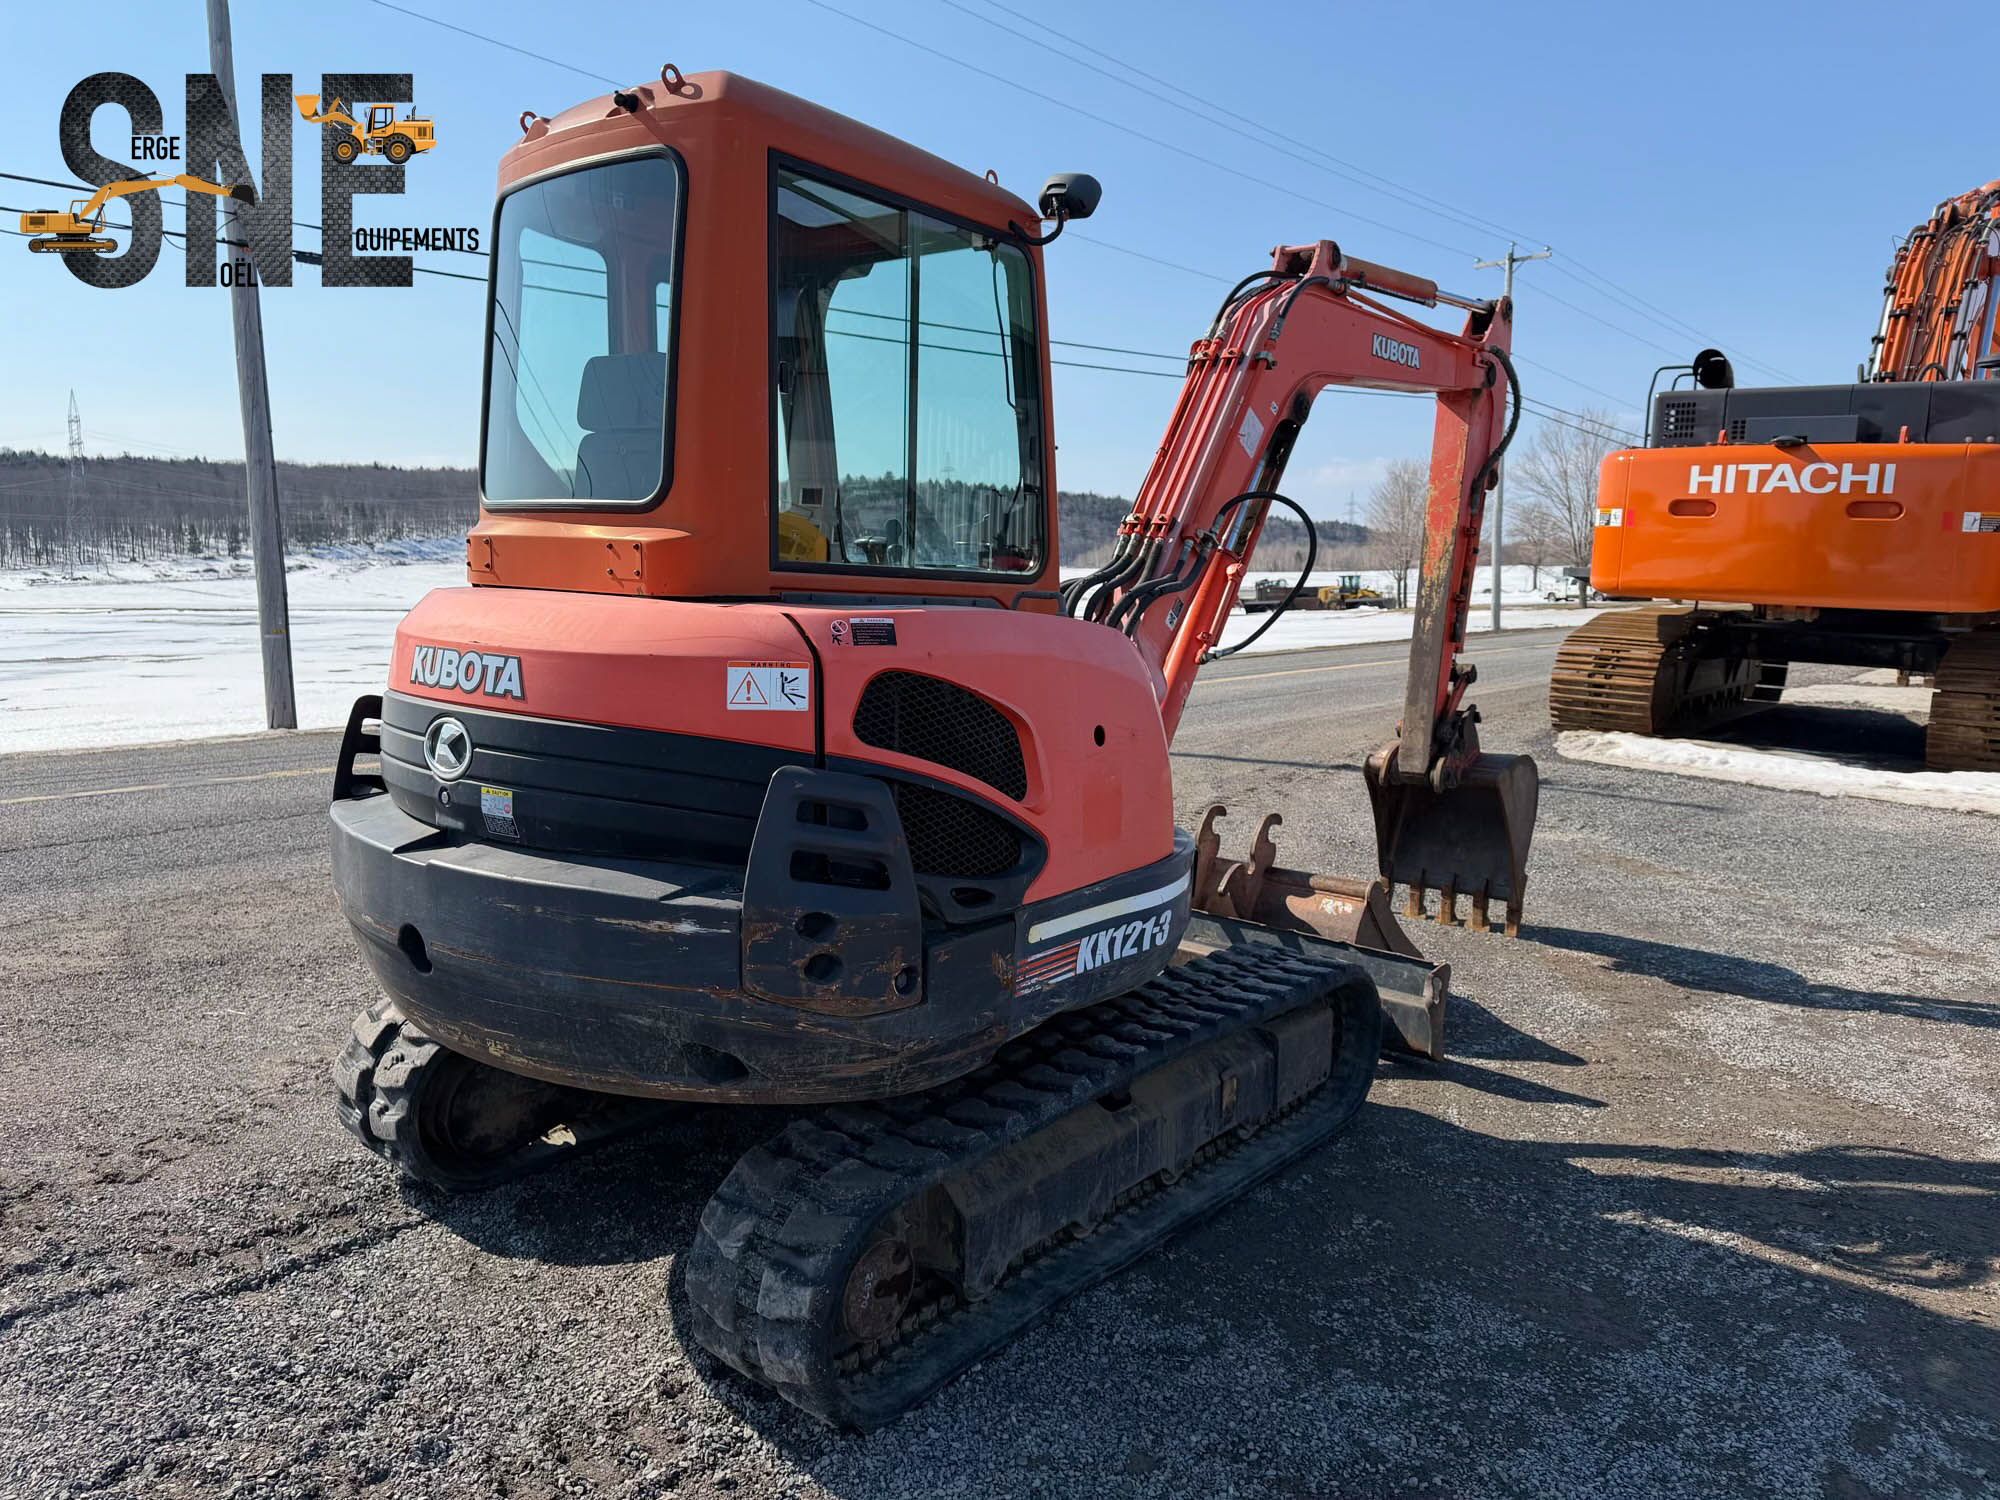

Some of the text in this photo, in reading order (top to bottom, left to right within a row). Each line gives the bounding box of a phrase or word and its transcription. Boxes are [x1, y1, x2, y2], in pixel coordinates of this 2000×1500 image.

[1372, 333, 1421, 369] KUBOTA
[1688, 463, 1897, 494] HITACHI
[410, 645, 525, 700] KUBOTA
[750, 661, 792, 669] WARNING
[1076, 909, 1172, 975] KX121-3
